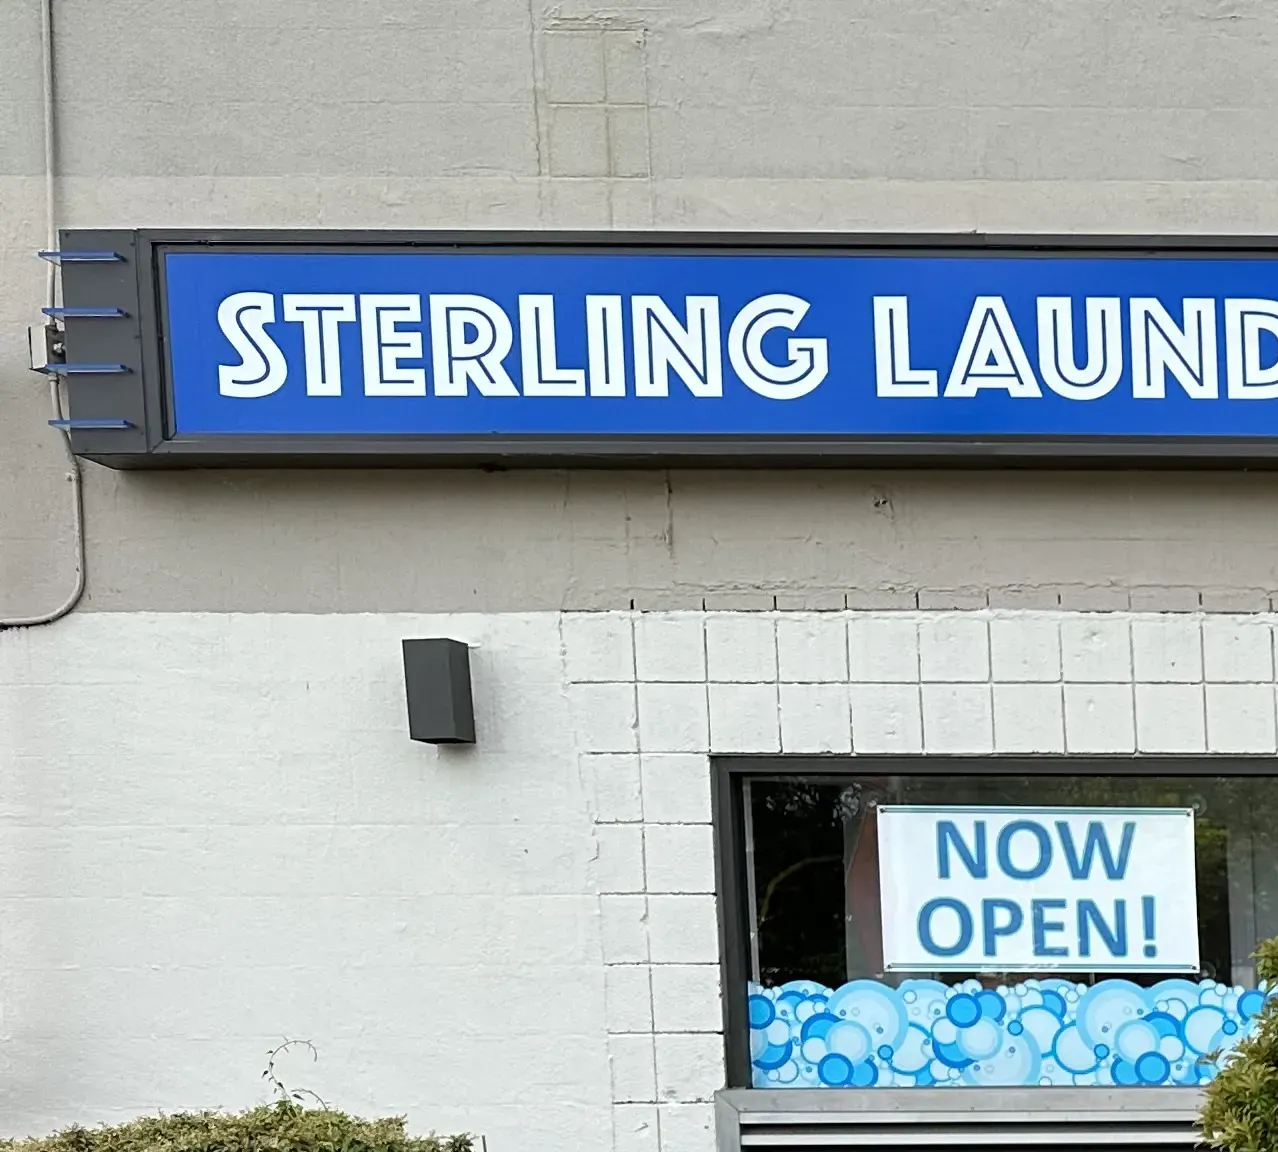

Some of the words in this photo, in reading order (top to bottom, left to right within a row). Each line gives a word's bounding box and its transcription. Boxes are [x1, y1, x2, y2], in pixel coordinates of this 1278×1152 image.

[216, 291, 829, 399] STERLING
[935, 819, 1137, 881] NOW
[916, 896, 1157, 958] OPEN!
